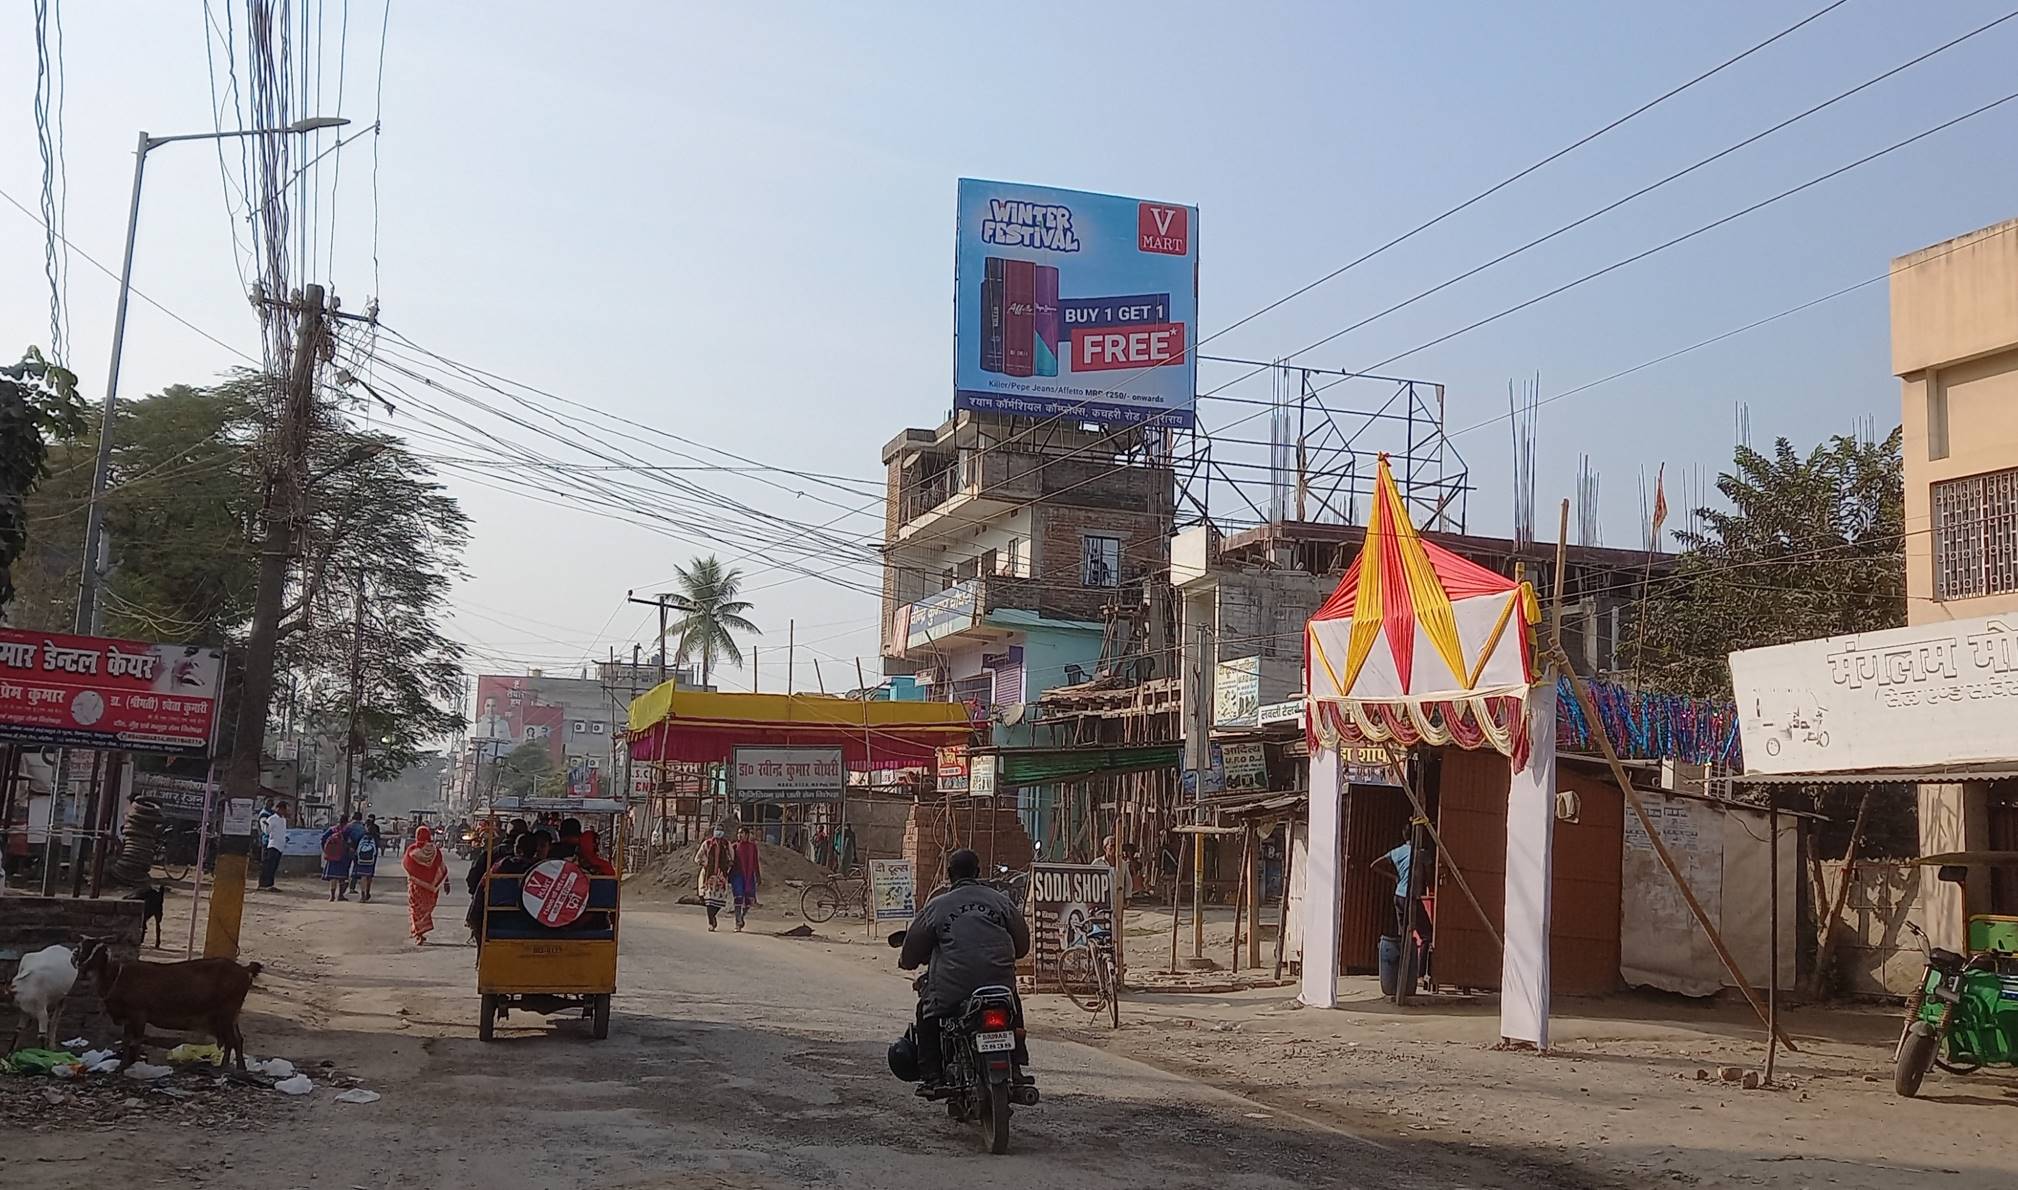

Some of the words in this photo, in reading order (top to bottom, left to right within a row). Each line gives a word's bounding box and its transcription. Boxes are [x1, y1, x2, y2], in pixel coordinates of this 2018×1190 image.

[991, 199, 1072, 229] WINTER
[1151, 208, 1176, 236] V
[982, 220, 1080, 251] FESTIVAL
[1142, 238, 1183, 252] MART
[1064, 307, 1099, 323] BUY
[1104, 306, 1113, 321] 1
[1118, 304, 1151, 320] GET
[1155, 304, 1164, 319] 1
[969, 396, 993, 408] श्याम
[1091, 407, 1121, 421] कचहरी
[1131, 393, 1164, 403] onwards
[44, 640, 100, 674] डेन्टल
[107, 645, 156, 679] केयर
[1827, 637, 1958, 689] मंगलम
[27, 687, 66, 706] कुमार
[786, 762, 810, 781] कुमार
[1035, 871, 1071, 902] SODA
[1074, 872, 1109, 903] SHOP
